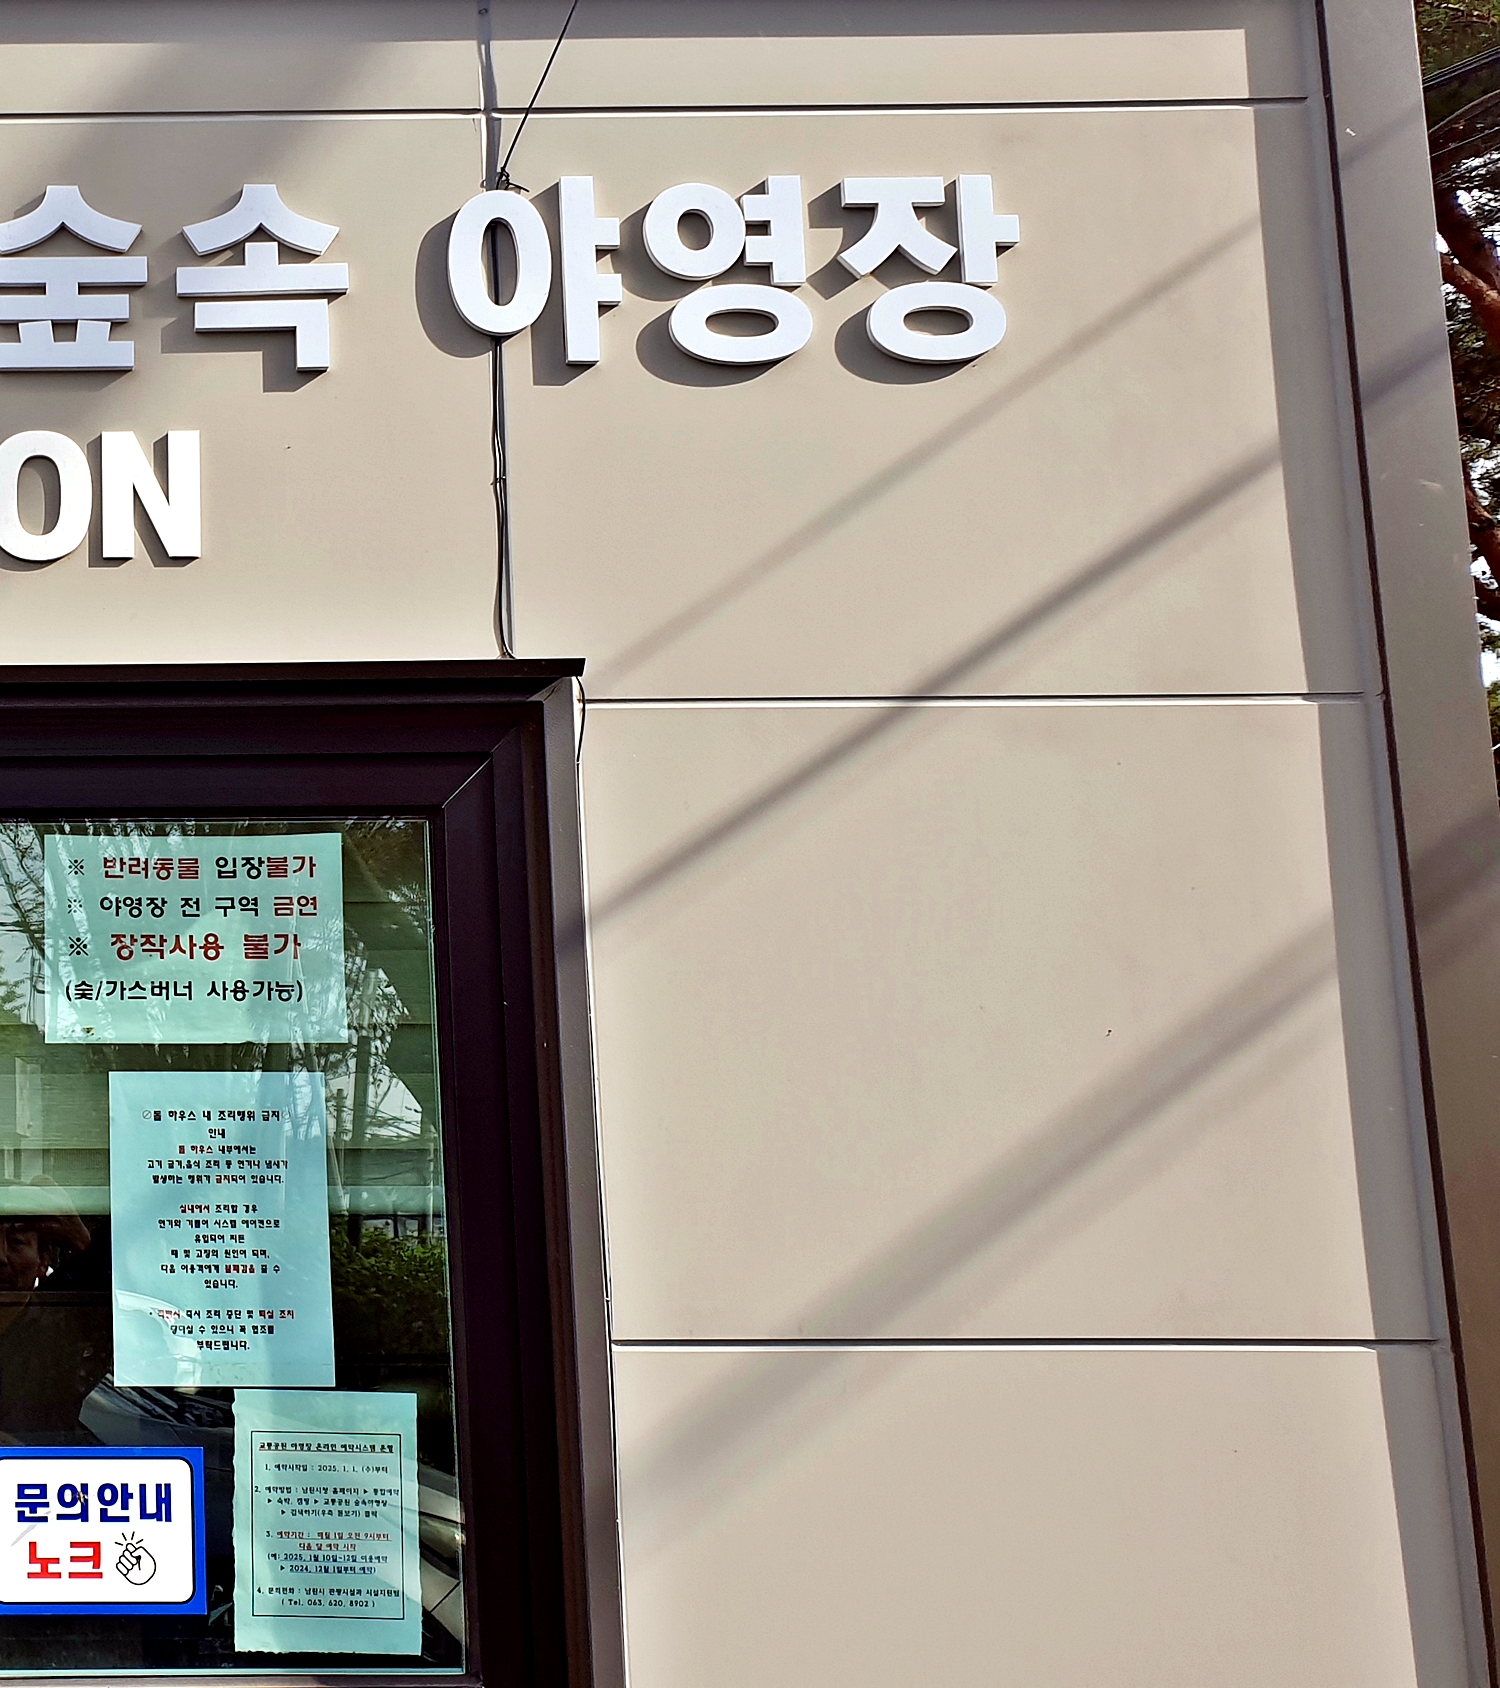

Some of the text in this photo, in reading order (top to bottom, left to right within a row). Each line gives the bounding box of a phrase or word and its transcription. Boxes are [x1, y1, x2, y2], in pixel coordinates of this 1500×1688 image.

[447, 174, 1020, 365] 야영장
[103, 857, 200, 880] 반려동물
[215, 857, 316, 880] 입장불가
[100, 896, 167, 918] 야영장
[180, 896, 200, 917] 전
[215, 896, 259, 917] 구역
[274, 896, 317, 917] 금연
[110, 933, 224, 961] 장작사용
[243, 933, 301, 960] 불가
[207, 979, 302, 1001] 사용가능)
[168, 1111, 196, 1121] 하우스
[203, 1111, 211, 1121] 내
[218, 1111, 256, 1121] 조리행위
[262, 1111, 280, 1121] 금지
[208, 1128, 225, 1139] 안내
[191, 1145, 213, 1154] 하우스
[219, 1145, 256, 1154] 내부에서는
[148, 1160, 162, 1169] 고기
[206, 1160, 220, 1169] 조리
[237, 1160, 260, 1169] 연기나
[265, 1160, 288, 1169] 냄새가
[153, 1175, 284, 1184] 발생하는 행위가 금지되어 있습니다.
[180, 1204, 210, 1214] 실내에서
[243, 1204, 258, 1214] 경우
[158, 1219, 181, 1228] 연기와
[214, 1219, 237, 1228] 시스템
[241, 1219, 280, 1228] 에어컨으로
[194, 1234, 225, 1244] 유입되어
[196, 1249, 218, 1258] 고장의
[224, 1249, 247, 1258] 원인이
[161, 1264, 176, 1274] 다음
[273, 1264, 280, 1274] 수
[204, 1279, 238, 1288] 있습니다.
[206, 1310, 220, 1319] 조리
[226, 1310, 241, 1319] 중단
[279, 1310, 294, 1319] 조치
[199, 1325, 206, 1334] 수
[211, 1325, 234, 1334] 있으니
[197, 1341, 250, 1350] 부탁드립니다.
[315, 1443, 337, 1451] 온라인
[15, 1483, 172, 1522] 문의안내
[27, 1541, 103, 1579] 노크
[349, 1599, 369, 1607] 8902
